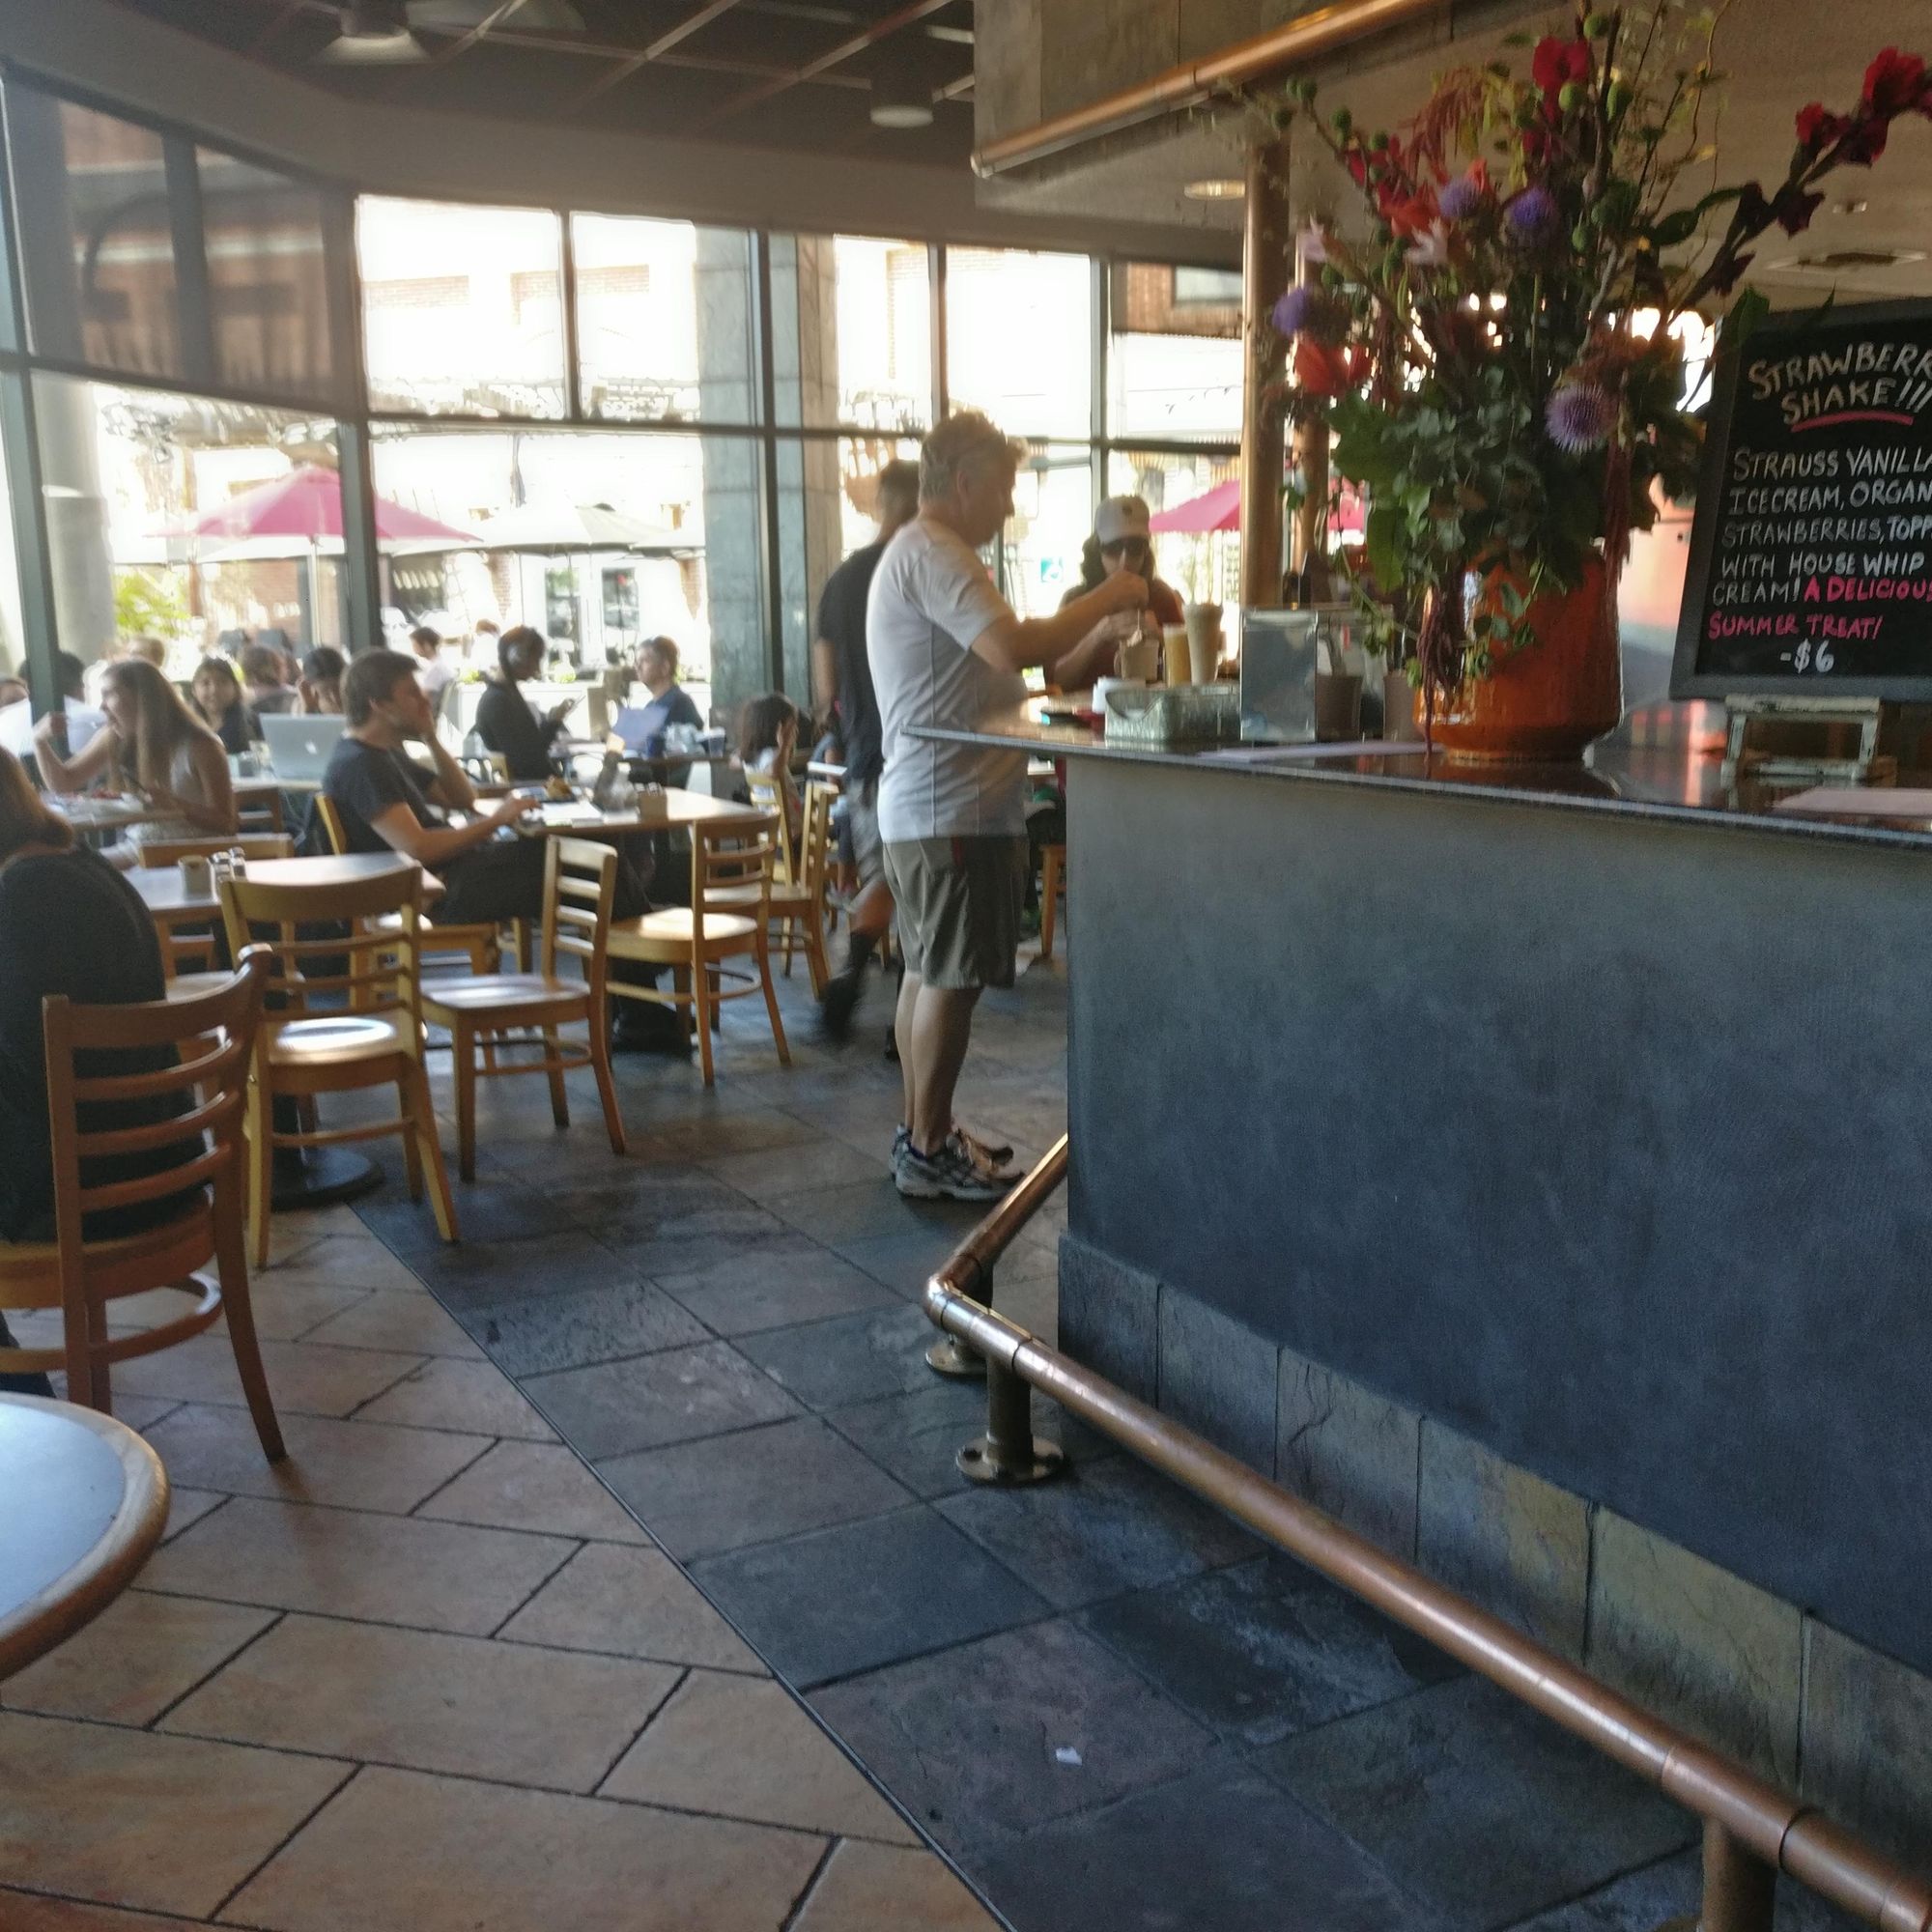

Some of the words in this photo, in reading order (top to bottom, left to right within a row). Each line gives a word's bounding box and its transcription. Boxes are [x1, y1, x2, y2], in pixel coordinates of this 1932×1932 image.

[1733, 445, 1839, 481] STRAUSS
[1849, 479, 1932, 508] ORGAN
[1721, 553, 1776, 579] WITH
[1789, 550, 1856, 577] HOUSE
[1862, 550, 1925, 578] WHIP
[1713, 577, 1801, 606] CREAM!
[1804, 575, 1821, 603] A
[1708, 610, 1800, 639] SUMMER
[1805, 611, 1883, 640] TREAT!
